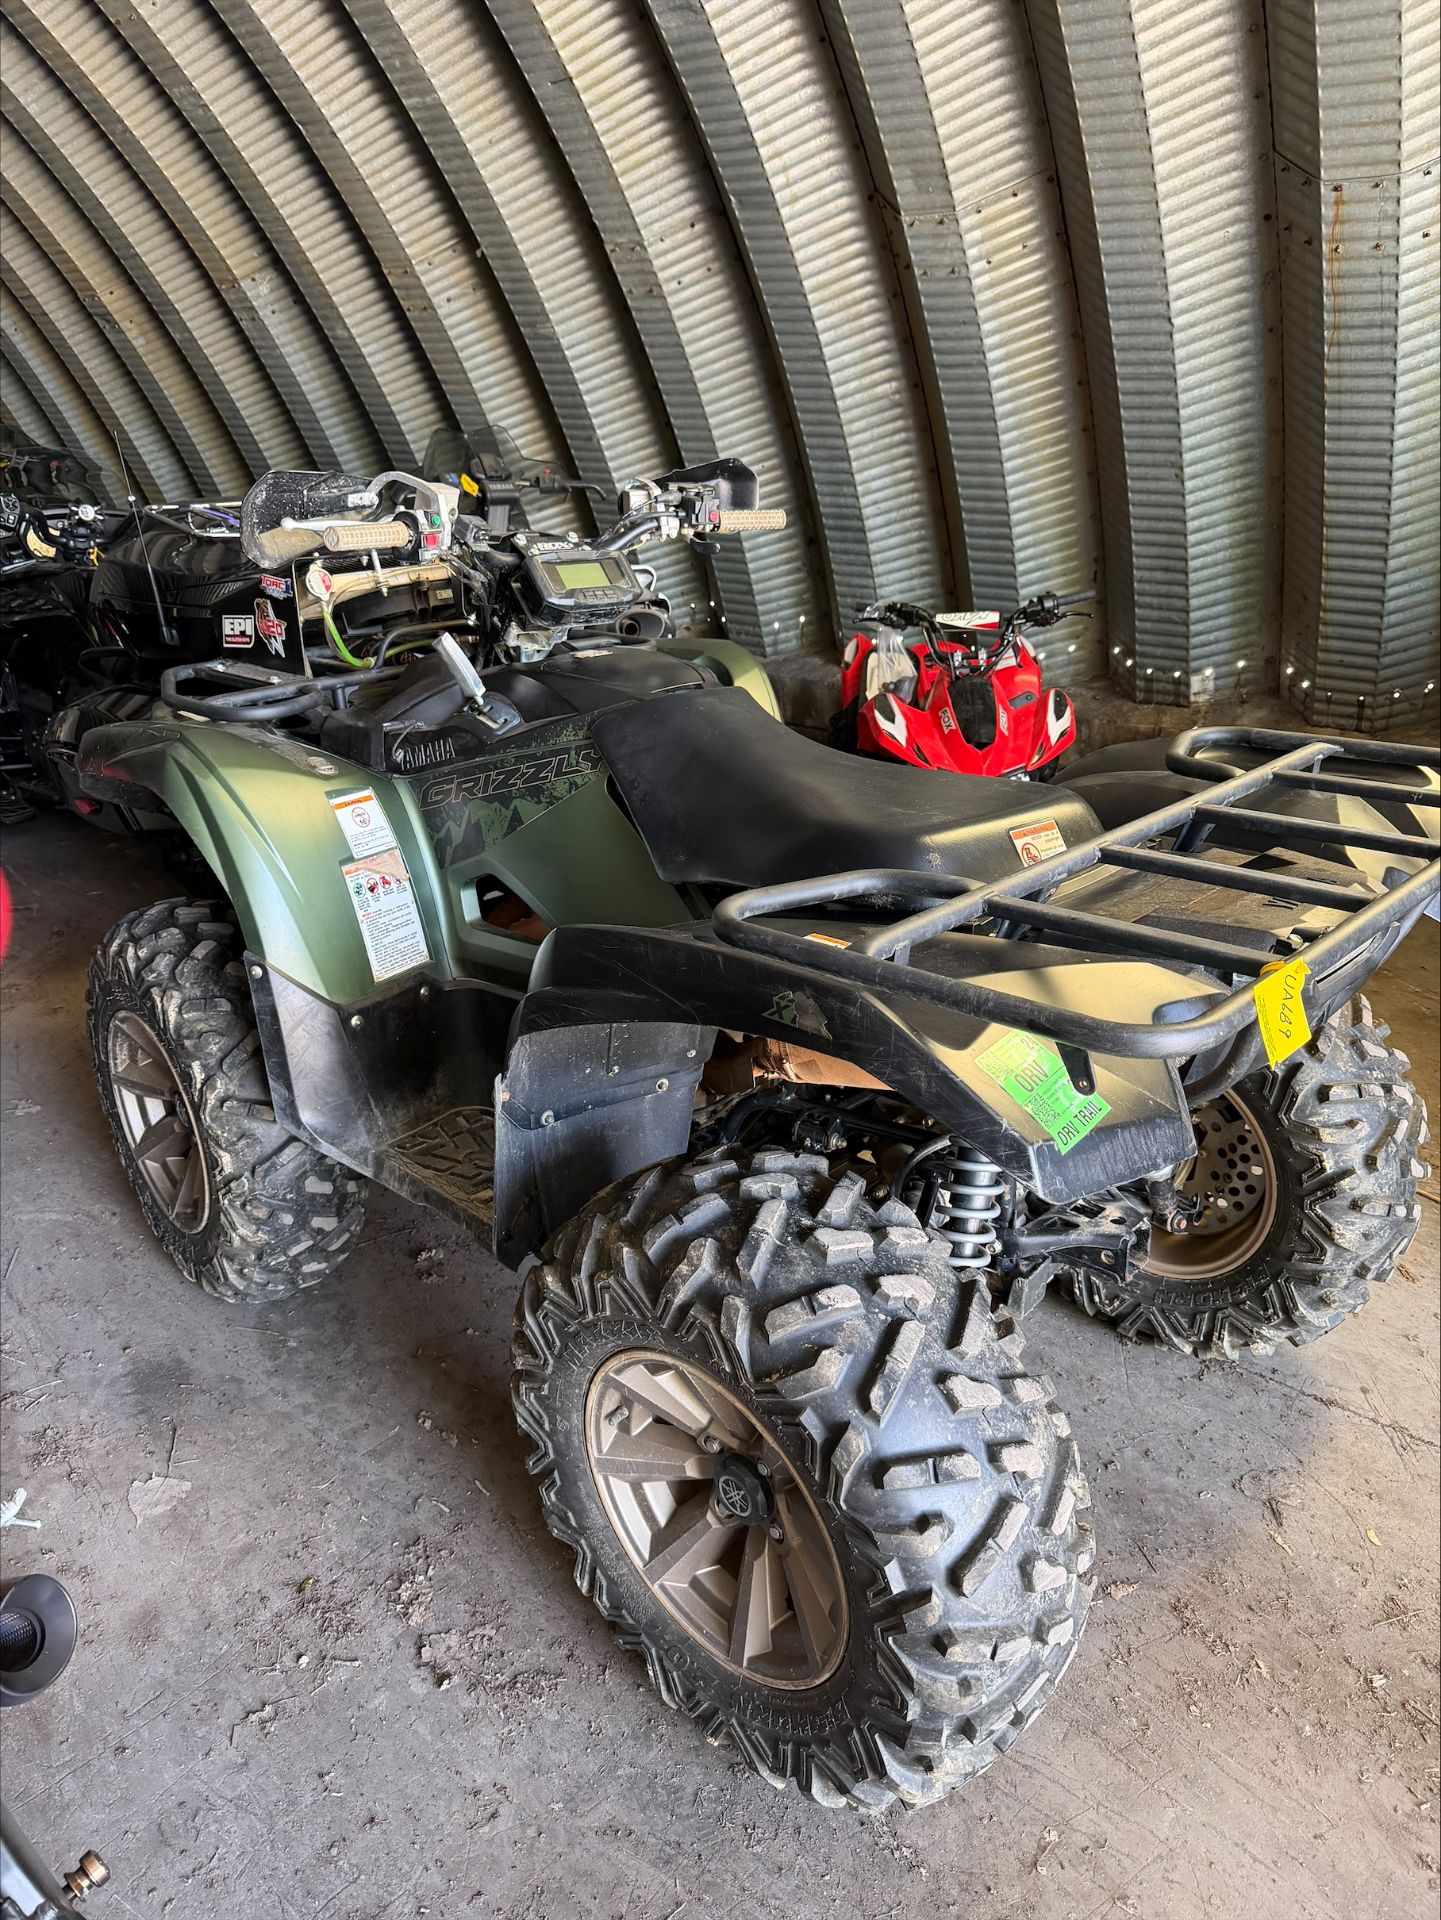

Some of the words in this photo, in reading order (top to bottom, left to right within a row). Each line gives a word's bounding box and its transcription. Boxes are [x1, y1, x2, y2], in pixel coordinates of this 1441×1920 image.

[224, 618, 252, 635] EPI
[941, 709, 953, 730] FOX
[418, 749, 604, 811] GRIZZLY
[1013, 1059, 1049, 1093] ORV
[1056, 1119, 1080, 1146] ORV
[1073, 1100, 1103, 1127] TRAIL
